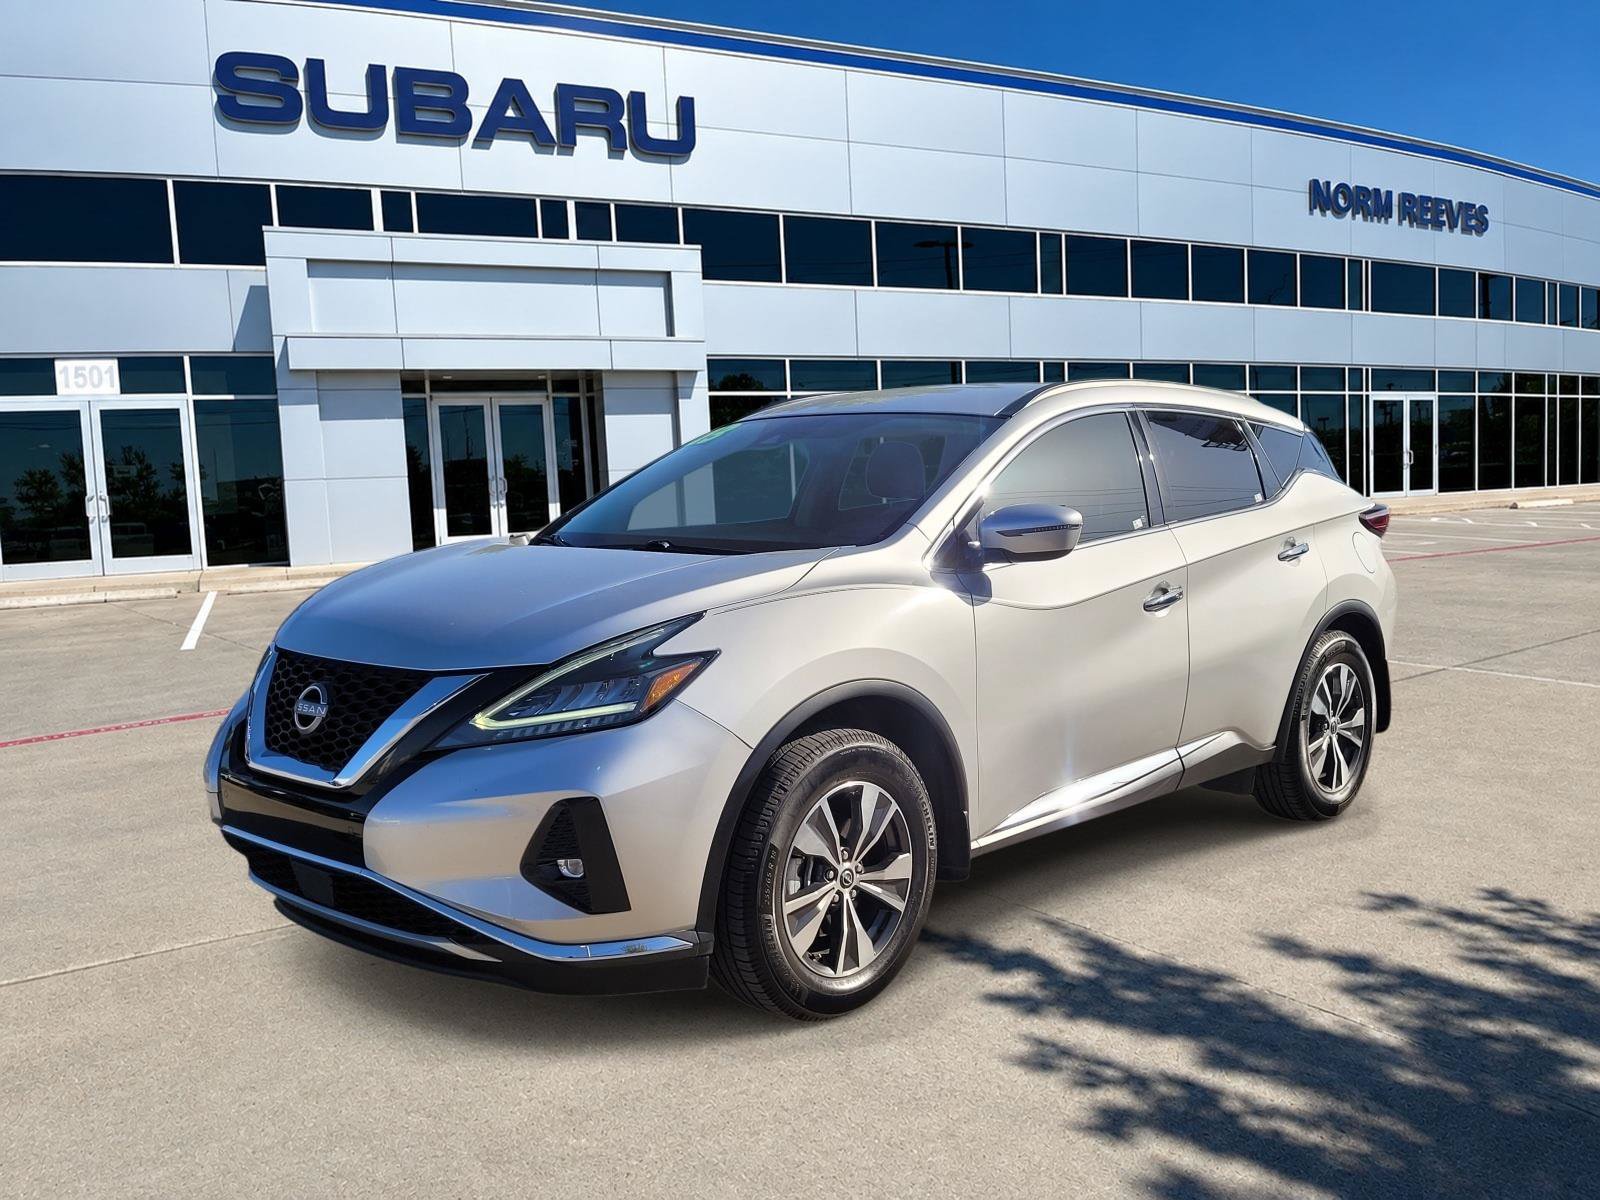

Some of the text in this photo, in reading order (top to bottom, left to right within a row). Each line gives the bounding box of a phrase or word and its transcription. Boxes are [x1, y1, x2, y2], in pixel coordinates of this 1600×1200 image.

[214, 51, 697, 157] SUBARU
[1308, 178, 1490, 235] NORM REEVES
[59, 365, 115, 389] 1501
[297, 703, 326, 715] SSAN
